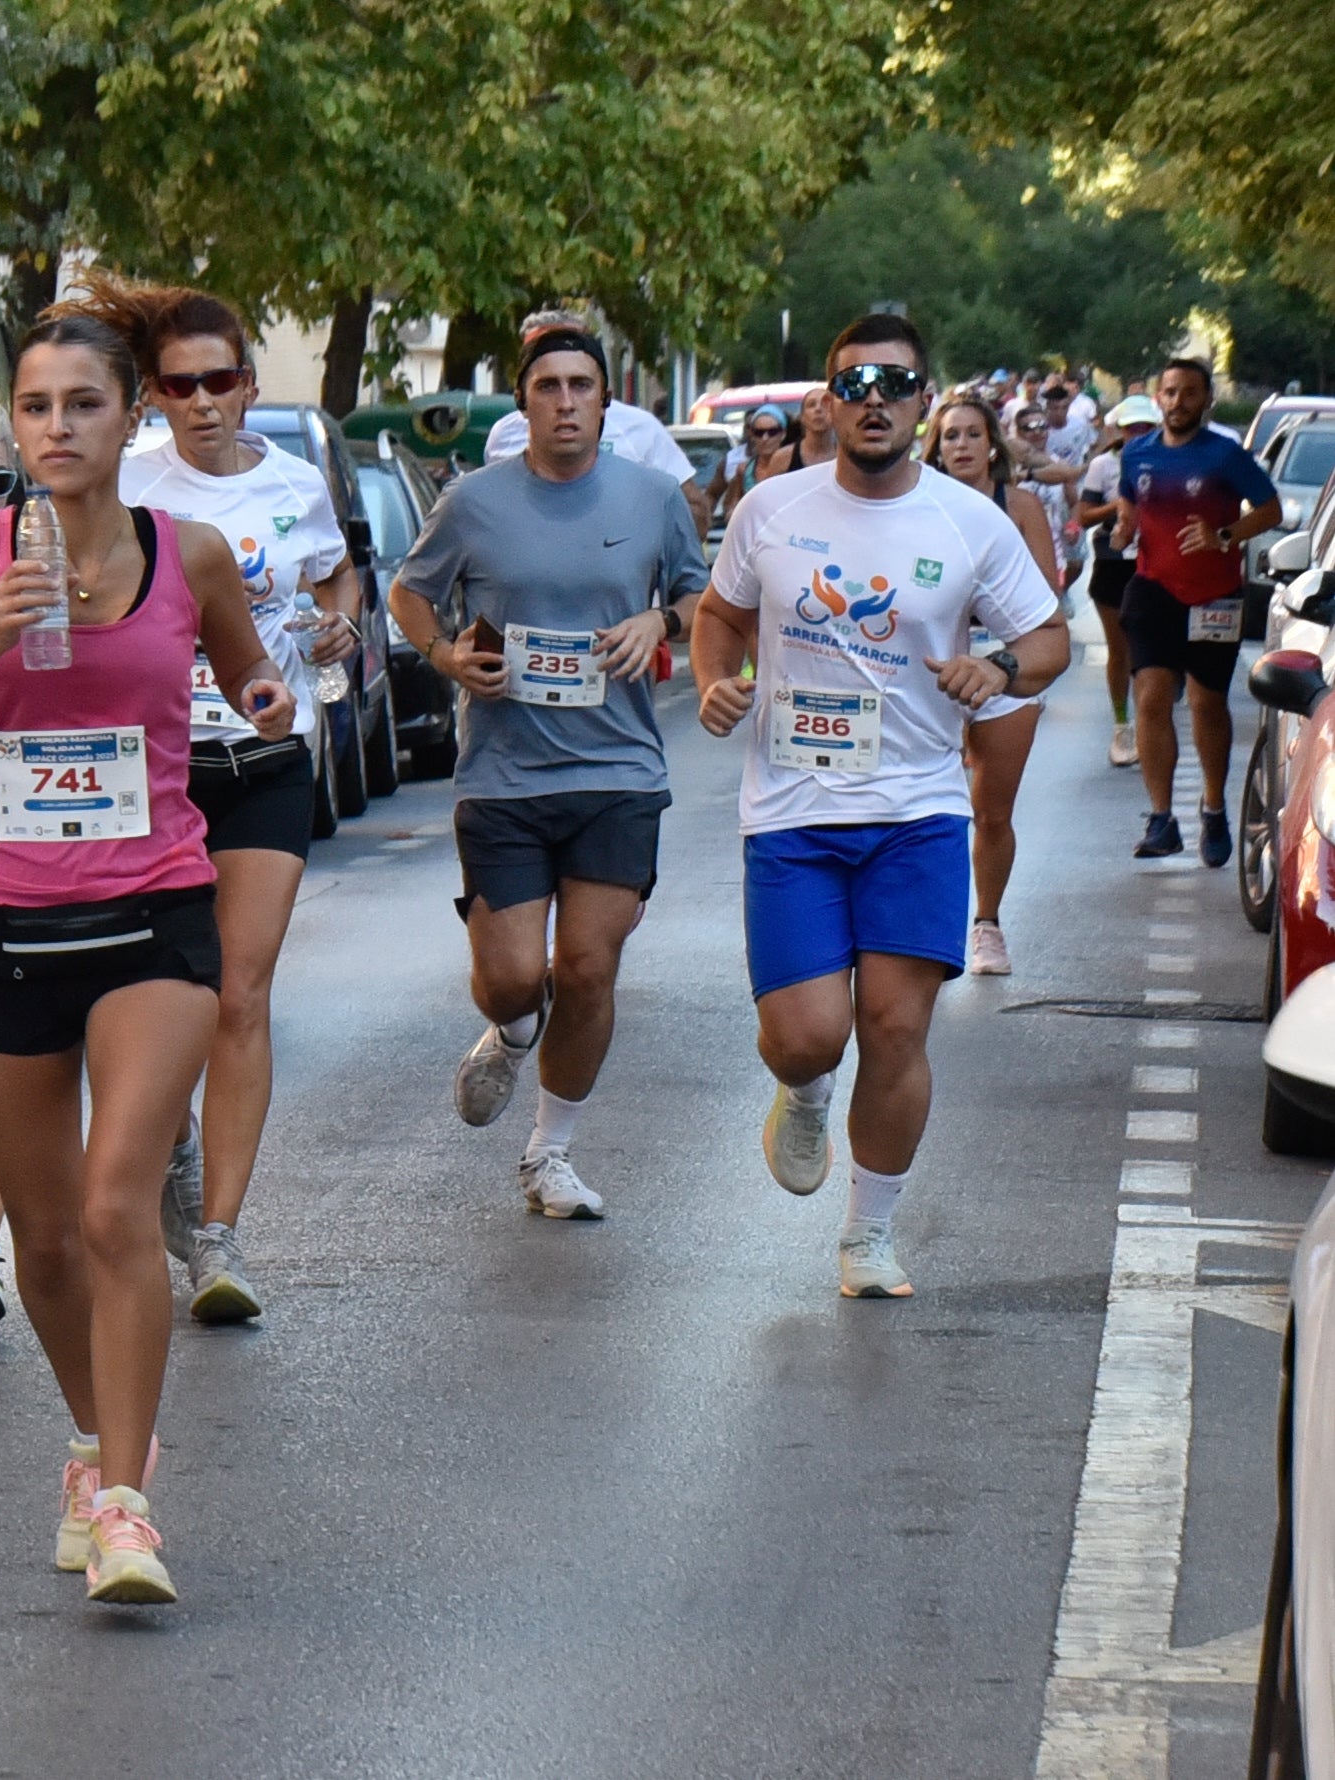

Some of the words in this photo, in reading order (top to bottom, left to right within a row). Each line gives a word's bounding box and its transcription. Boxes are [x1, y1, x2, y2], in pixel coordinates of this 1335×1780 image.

[527, 654, 579, 674] 235
[794, 714, 851, 737] 286
[31, 767, 103, 793] 741
